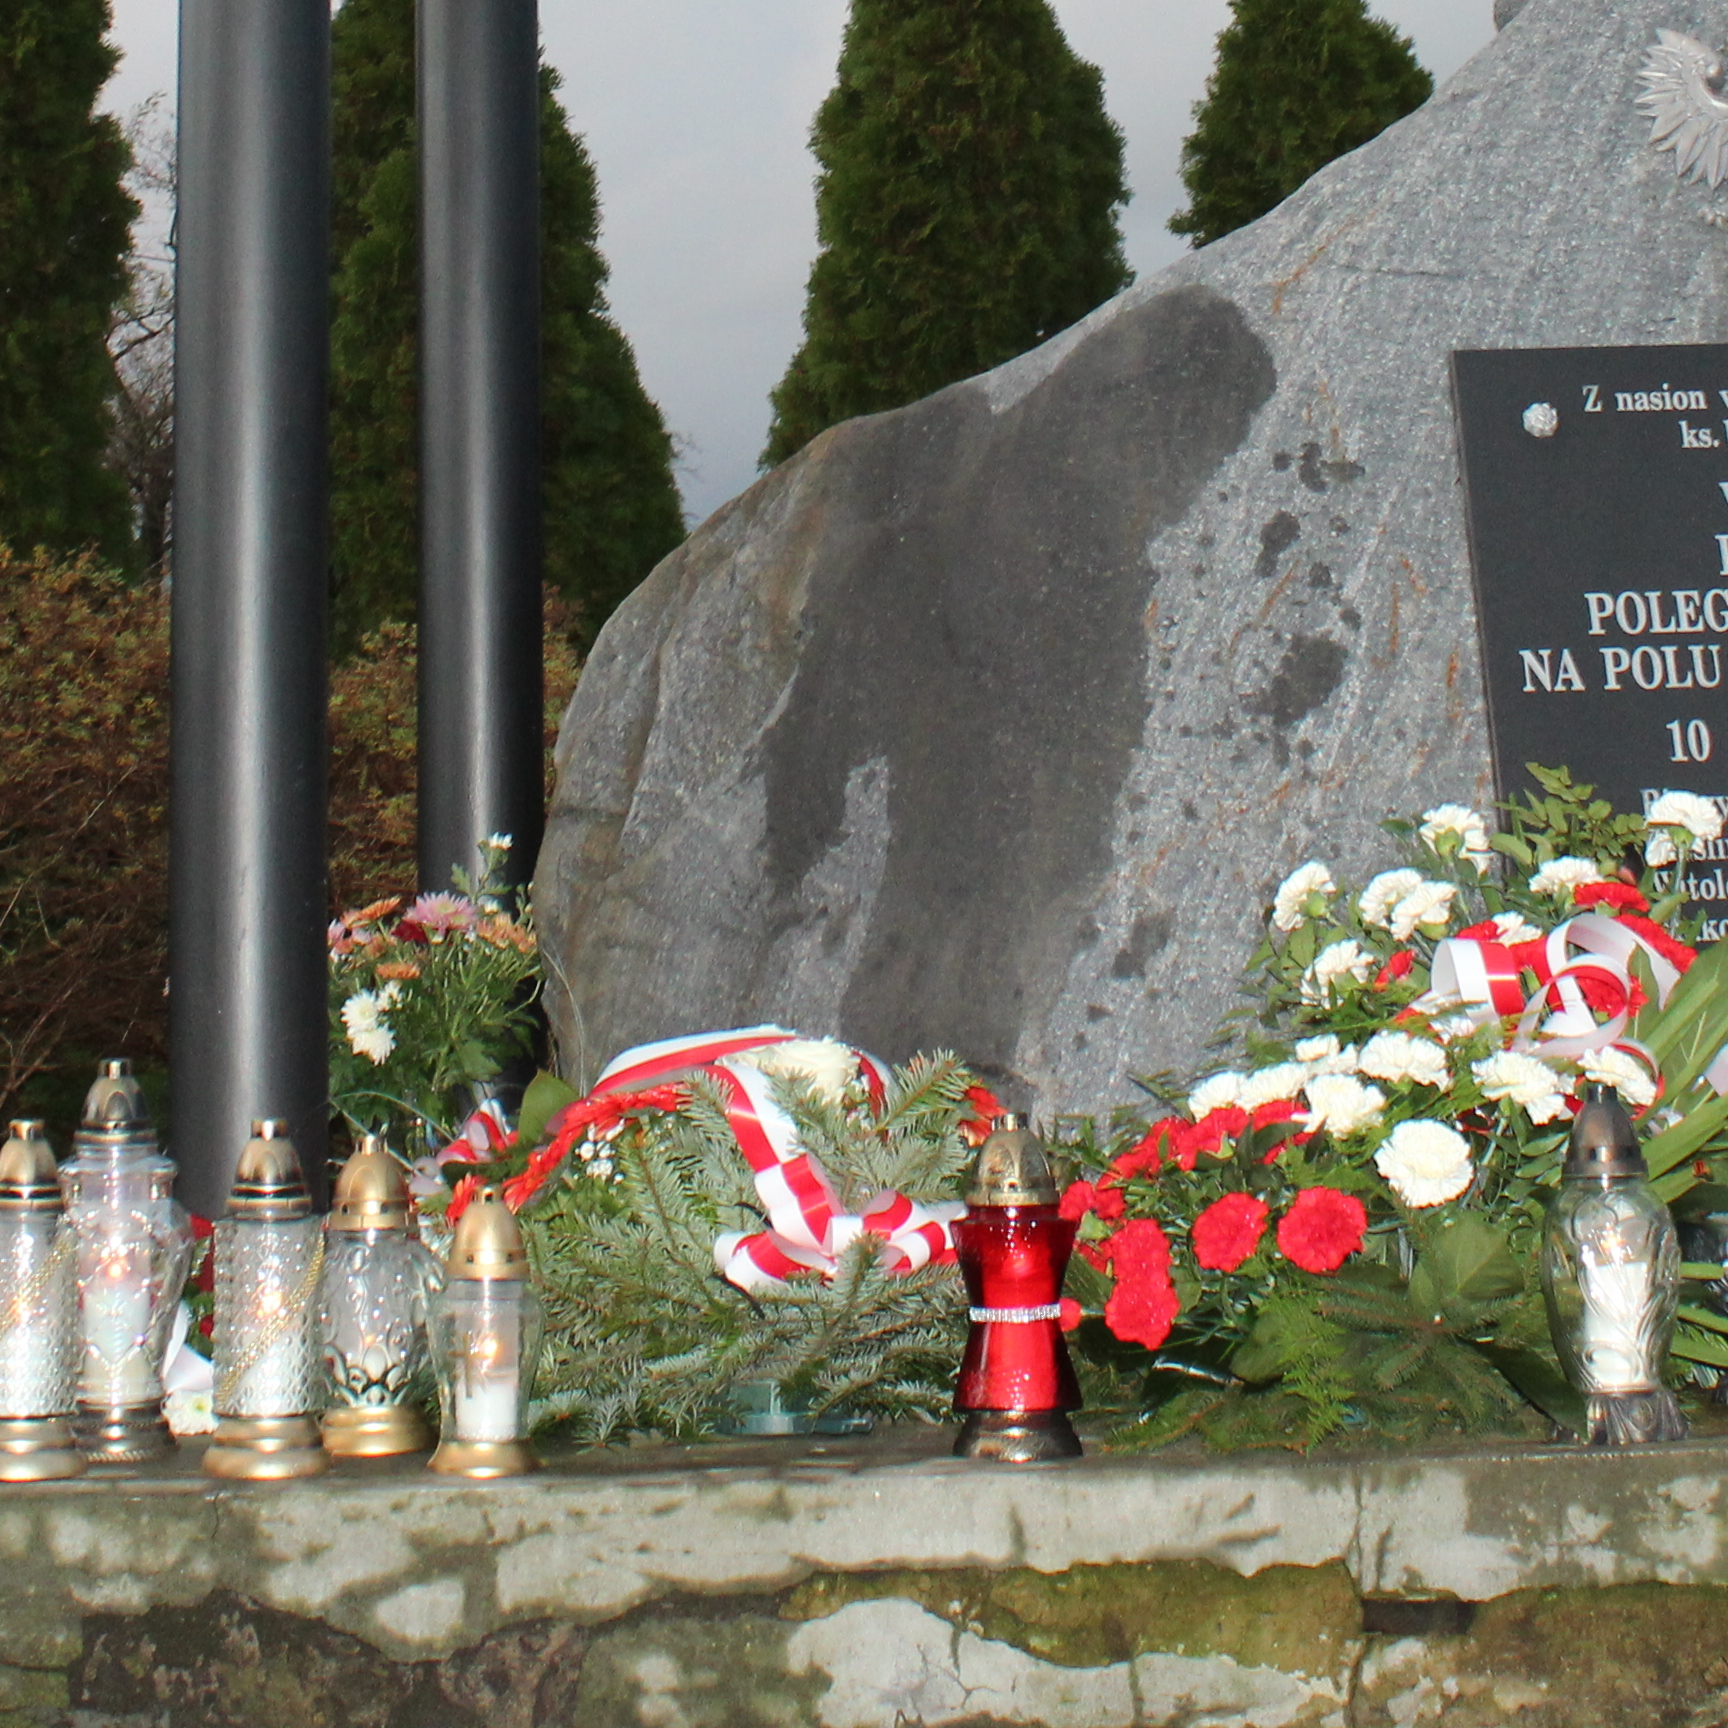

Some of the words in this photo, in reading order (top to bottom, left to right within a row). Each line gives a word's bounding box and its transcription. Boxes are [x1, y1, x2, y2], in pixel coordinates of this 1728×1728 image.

[1582, 384, 1602, 413] Z
[1615, 383, 1708, 412] nasion
[1679, 420, 1720, 449] ks.
[1518, 648, 1586, 692] NA
[1599, 645, 1721, 690] POLU
[1666, 718, 1712, 762] 10
